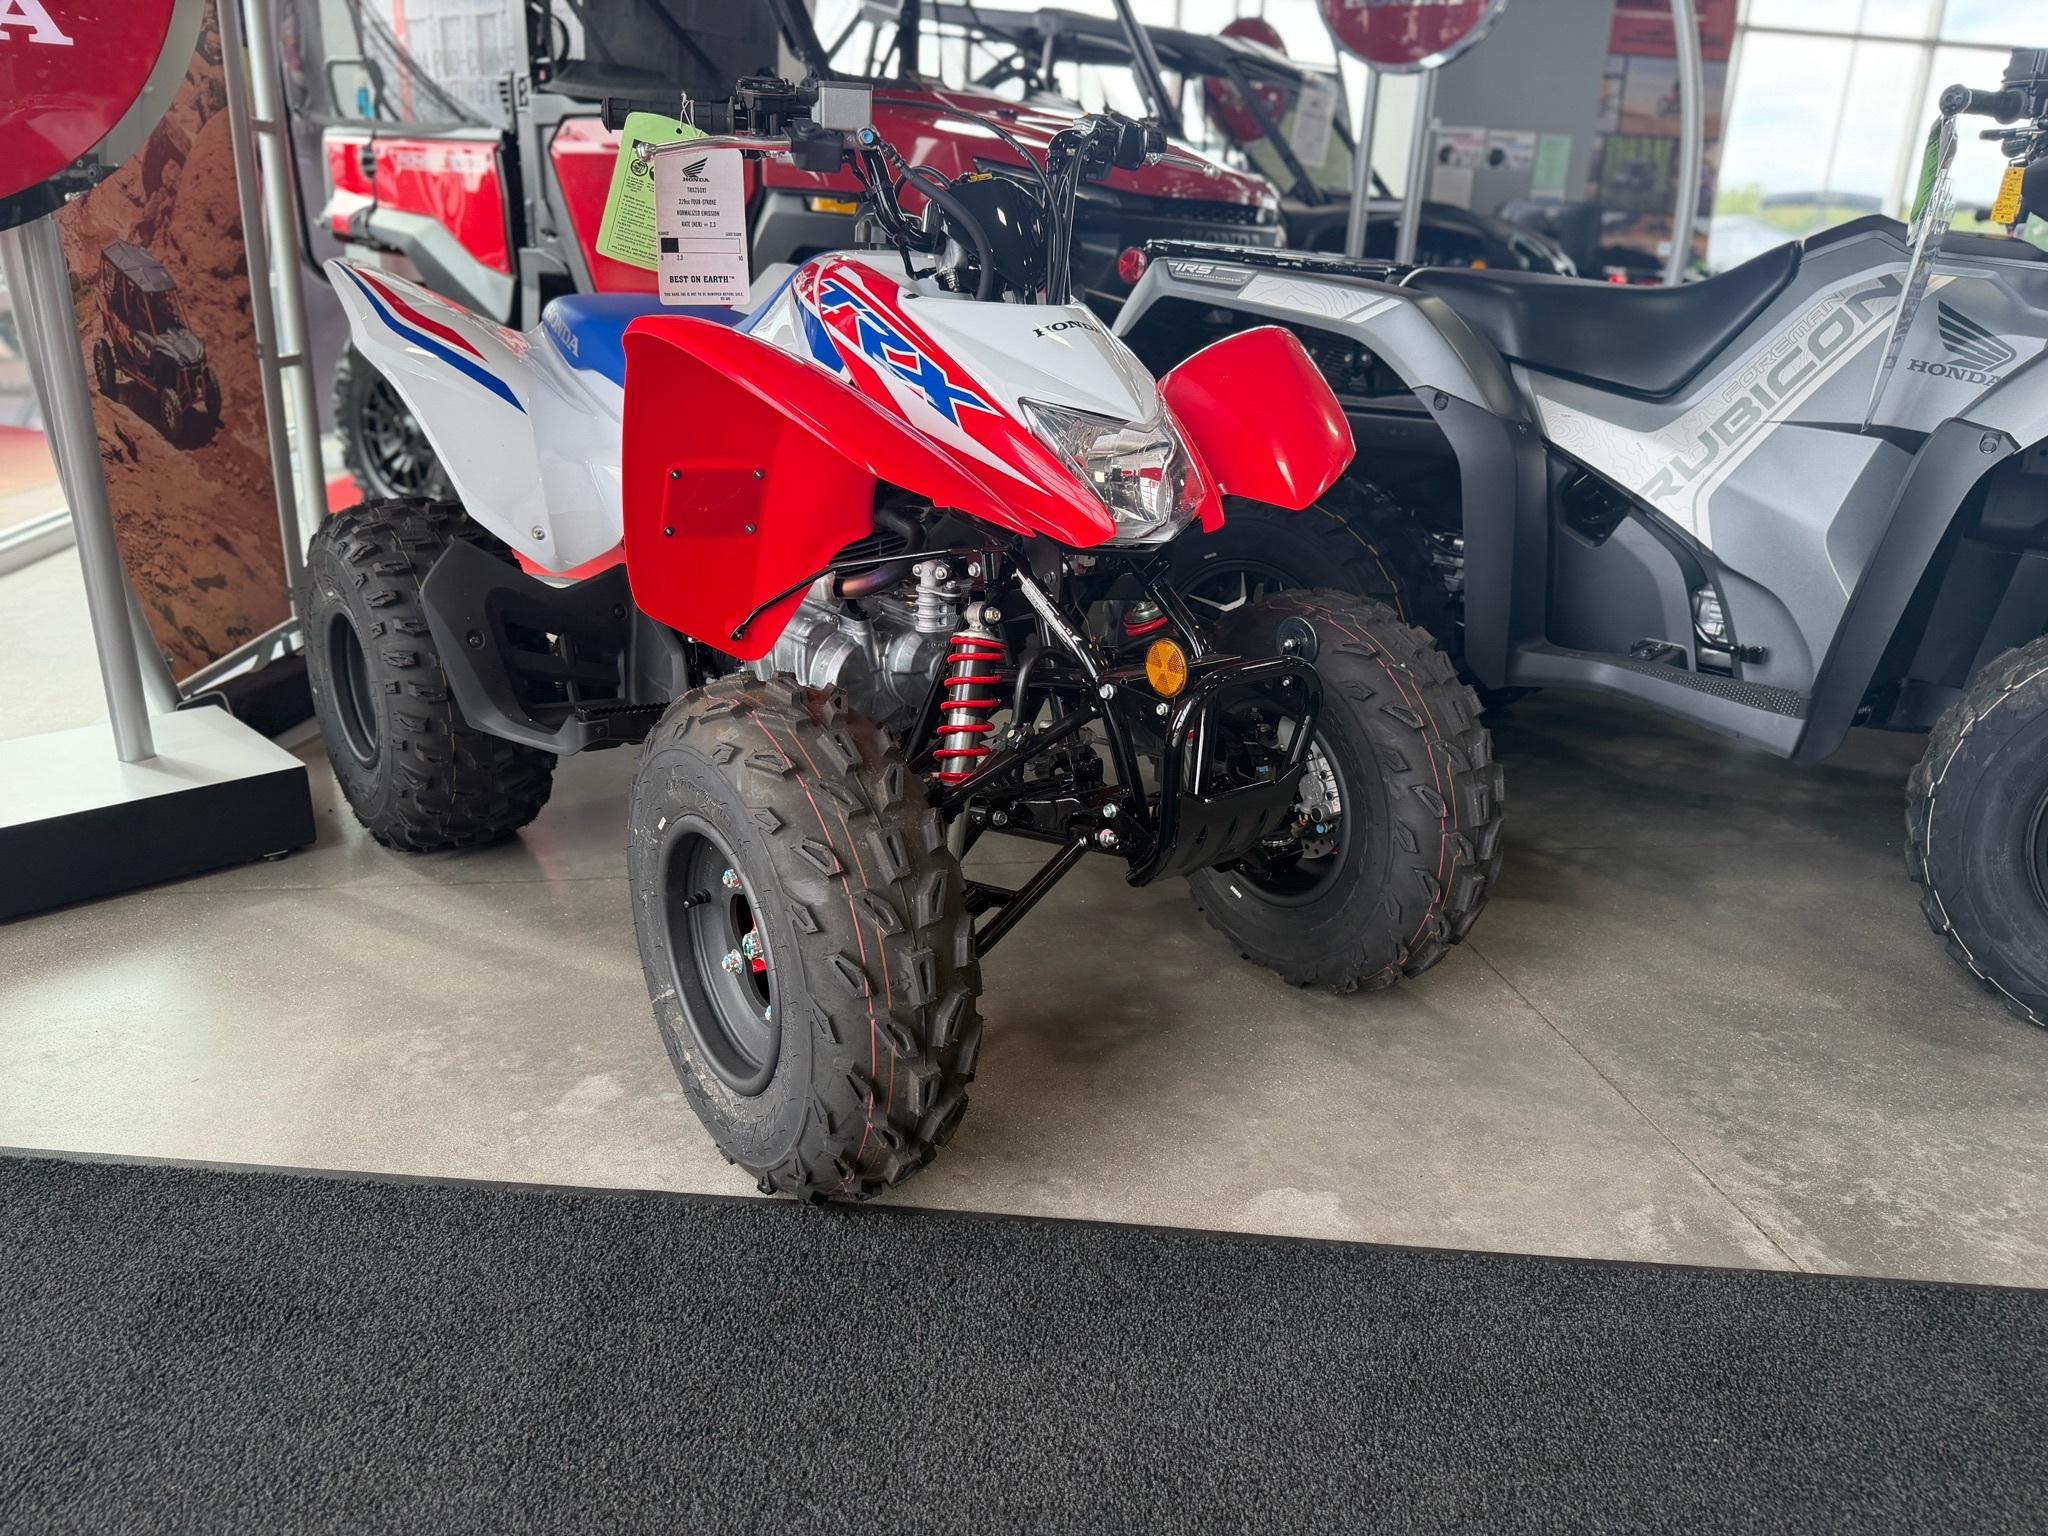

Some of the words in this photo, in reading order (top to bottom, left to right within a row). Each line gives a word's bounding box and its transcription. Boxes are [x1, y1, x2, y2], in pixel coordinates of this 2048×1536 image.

[1175, 263, 1214, 274] IRS
[545, 303, 579, 358] HONDA
[820, 279, 997, 428] TRX
[1722, 290, 1846, 404] FOREMAN
[1906, 358, 2002, 386] HONDA
[1637, 274, 1905, 502] RUBICON
